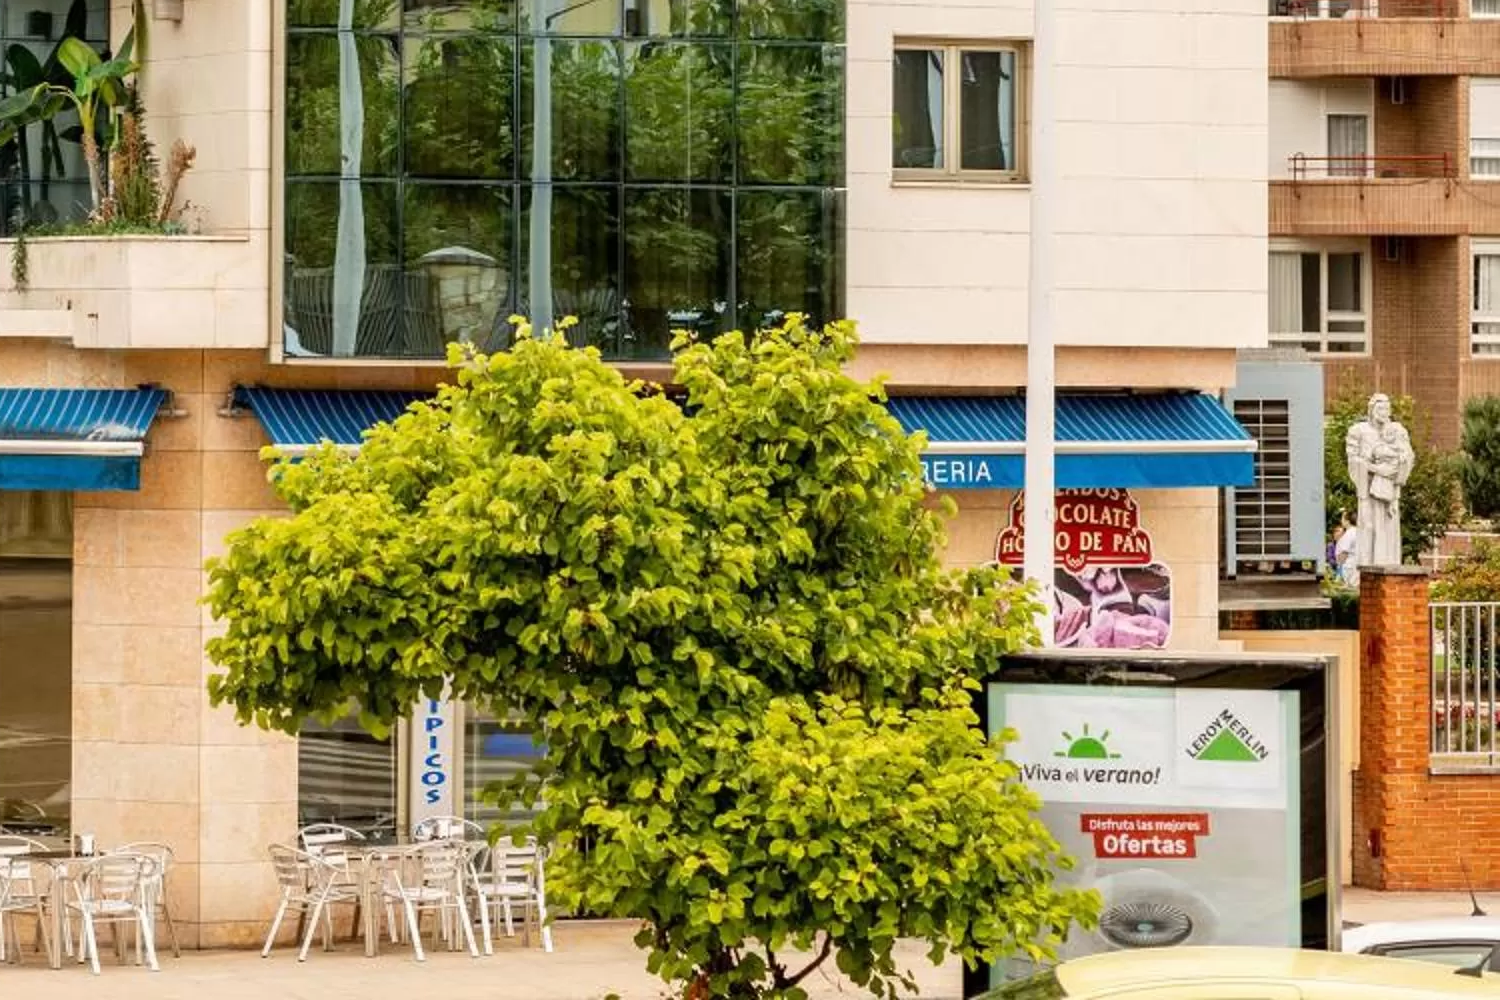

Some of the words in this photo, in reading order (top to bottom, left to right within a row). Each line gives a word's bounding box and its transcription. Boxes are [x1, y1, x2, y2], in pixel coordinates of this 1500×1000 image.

[919, 460, 993, 483] RERIA
[1019, 503, 1132, 529] COLATE
[1002, 531, 1071, 554] HOO
[1079, 531, 1103, 551] DE
[1113, 533, 1149, 553] PAN
[1185, 718, 1223, 759] LEROY
[1219, 708, 1269, 760] MERLIN
[1018, 763, 1061, 783] ¡Viva
[1065, 767, 1079, 783] el
[1083, 766, 1161, 785] verano!
[1089, 818, 1135, 831] Disfruta
[1137, 819, 1153, 831] las
[1155, 819, 1201, 833] mejores
[1102, 833, 1188, 855] Ofertas
